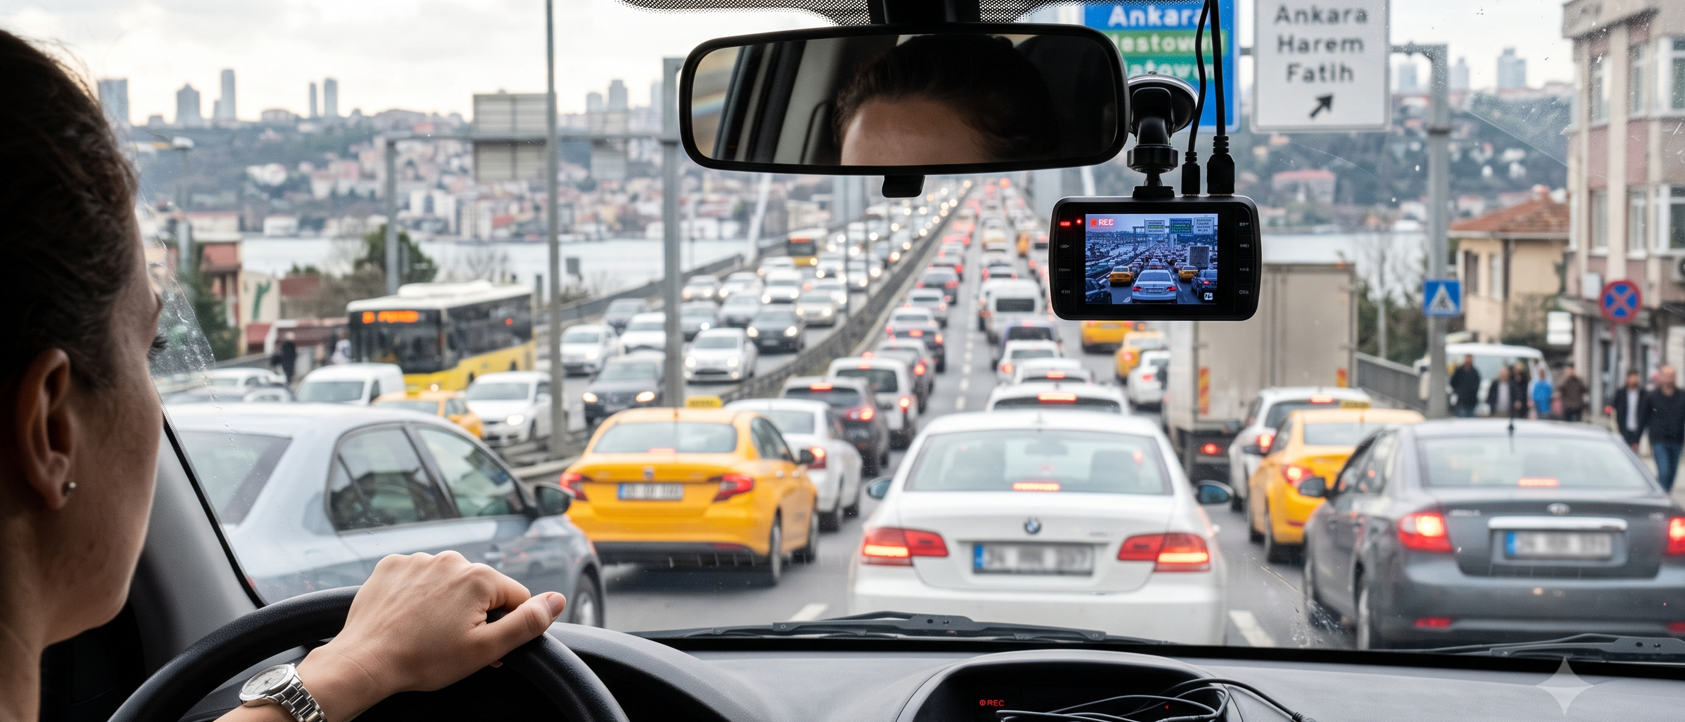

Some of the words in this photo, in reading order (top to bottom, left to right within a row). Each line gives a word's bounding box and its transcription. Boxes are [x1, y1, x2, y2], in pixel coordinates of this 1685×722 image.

[1107, 5, 1210, 27] Ankara
[1274, 4, 1368, 24] Ankara
[1277, 34, 1364, 54] Harem
[1286, 62, 1354, 83] Fatih
[987, 699, 1005, 707] REC
